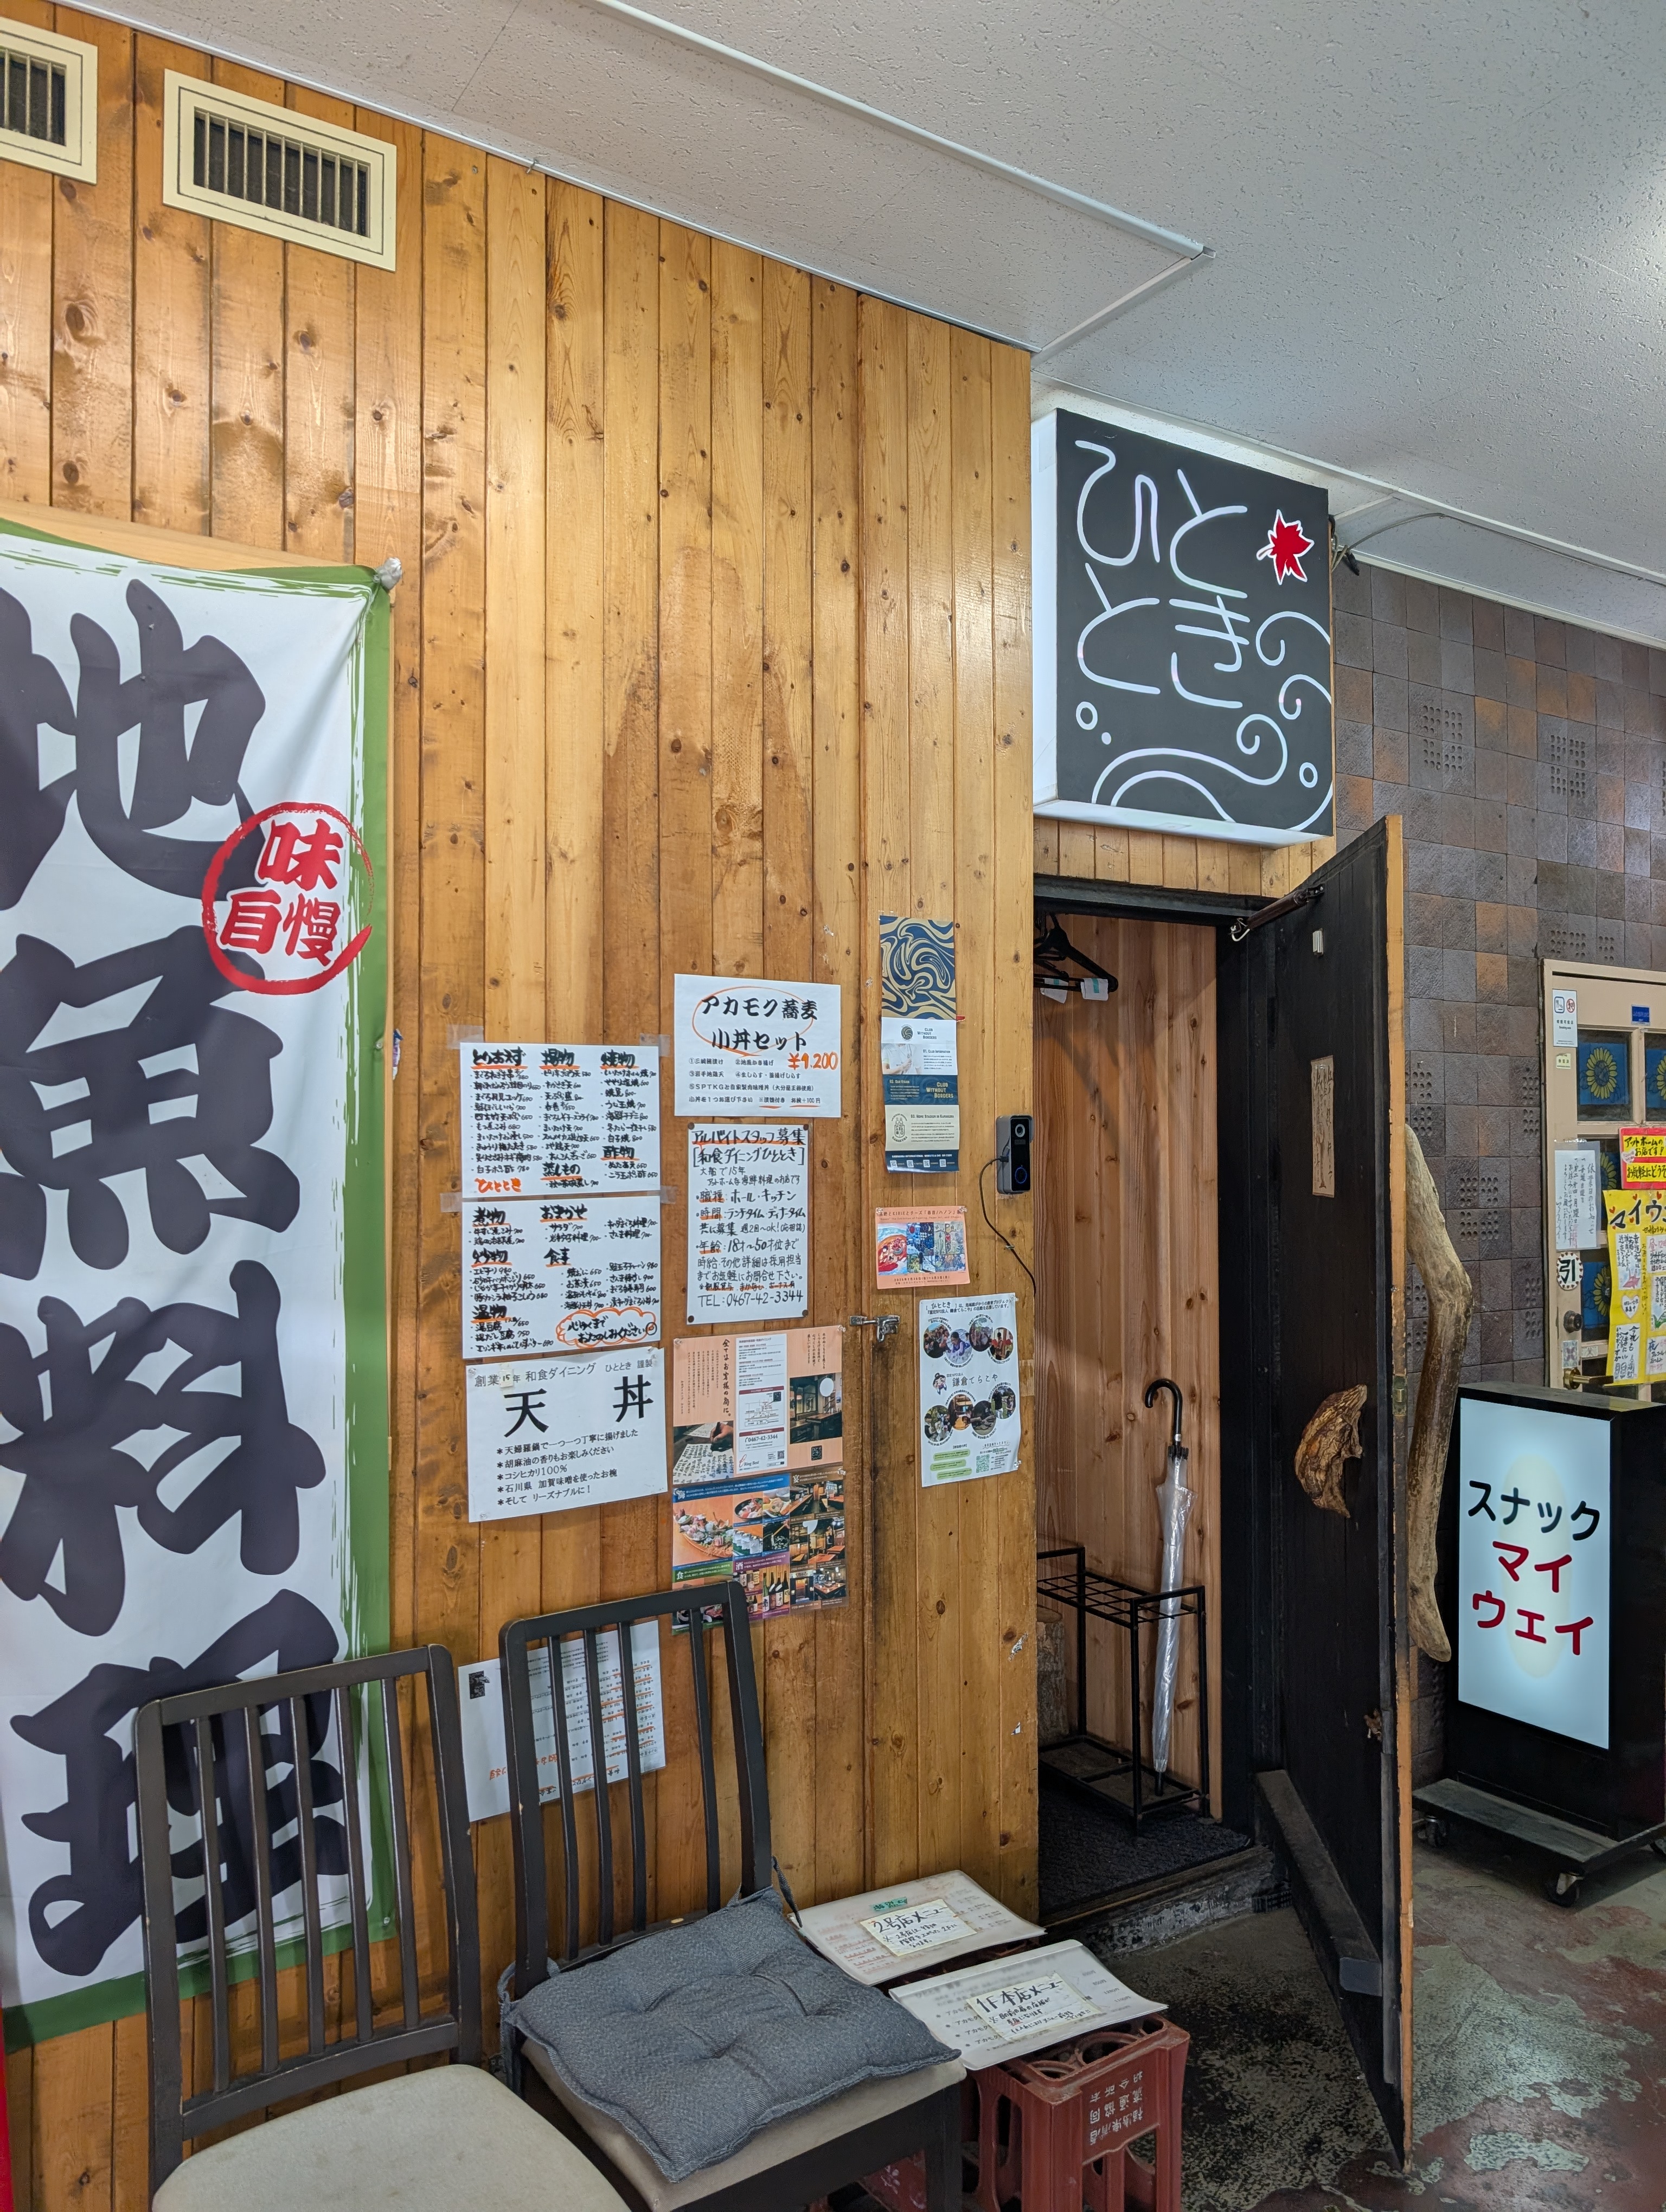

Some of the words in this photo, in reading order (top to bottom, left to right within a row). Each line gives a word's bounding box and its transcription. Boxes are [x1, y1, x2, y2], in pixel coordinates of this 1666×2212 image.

[1075, 439, 1248, 599] ひと
[1077, 562, 1251, 709] とき
[258, 819, 344, 892] 味
[219, 889, 341, 965] 自慢
[702, 996, 818, 1020] アカモク蕎麦
[712, 1028, 807, 1051] 小丼セット
[691, 1128, 806, 1146] アルバイトスタッフ募集
[1624, 1136, 1663, 1148] アットホームの
[699, 1221, 739, 1237] 共に募集
[543, 1246, 571, 1265] 食事
[0, 577, 348, 1977] 地魚料理
[1559, 1258, 1576, 1288] 引
[931, 1301, 952, 1310] ひととき
[525, 1362, 597, 1382] 和食ダイニング
[605, 1361, 633, 1373] ひととき
[952, 1373, 998, 1387] 鎌倉てらこや
[503, 1388, 549, 1438] 天
[612, 1374, 654, 1423] 丼
[748, 1433, 778, 1443] 0467-42-3344
[504, 1445, 615, 1469] 胡麻油の香りもお楽しみください
[504, 1464, 568, 1481] コシヒカリ100%
[504, 1481, 533, 1493] 石川県
[537, 1468, 618, 1490] 加賀味噌を使ったお椀
[504, 1496, 528, 1506] そして
[1467, 1480, 1600, 1541] スナック
[1492, 1540, 1572, 1593] マイ
[976, 1980, 1063, 2013] 1F本店メニュー
